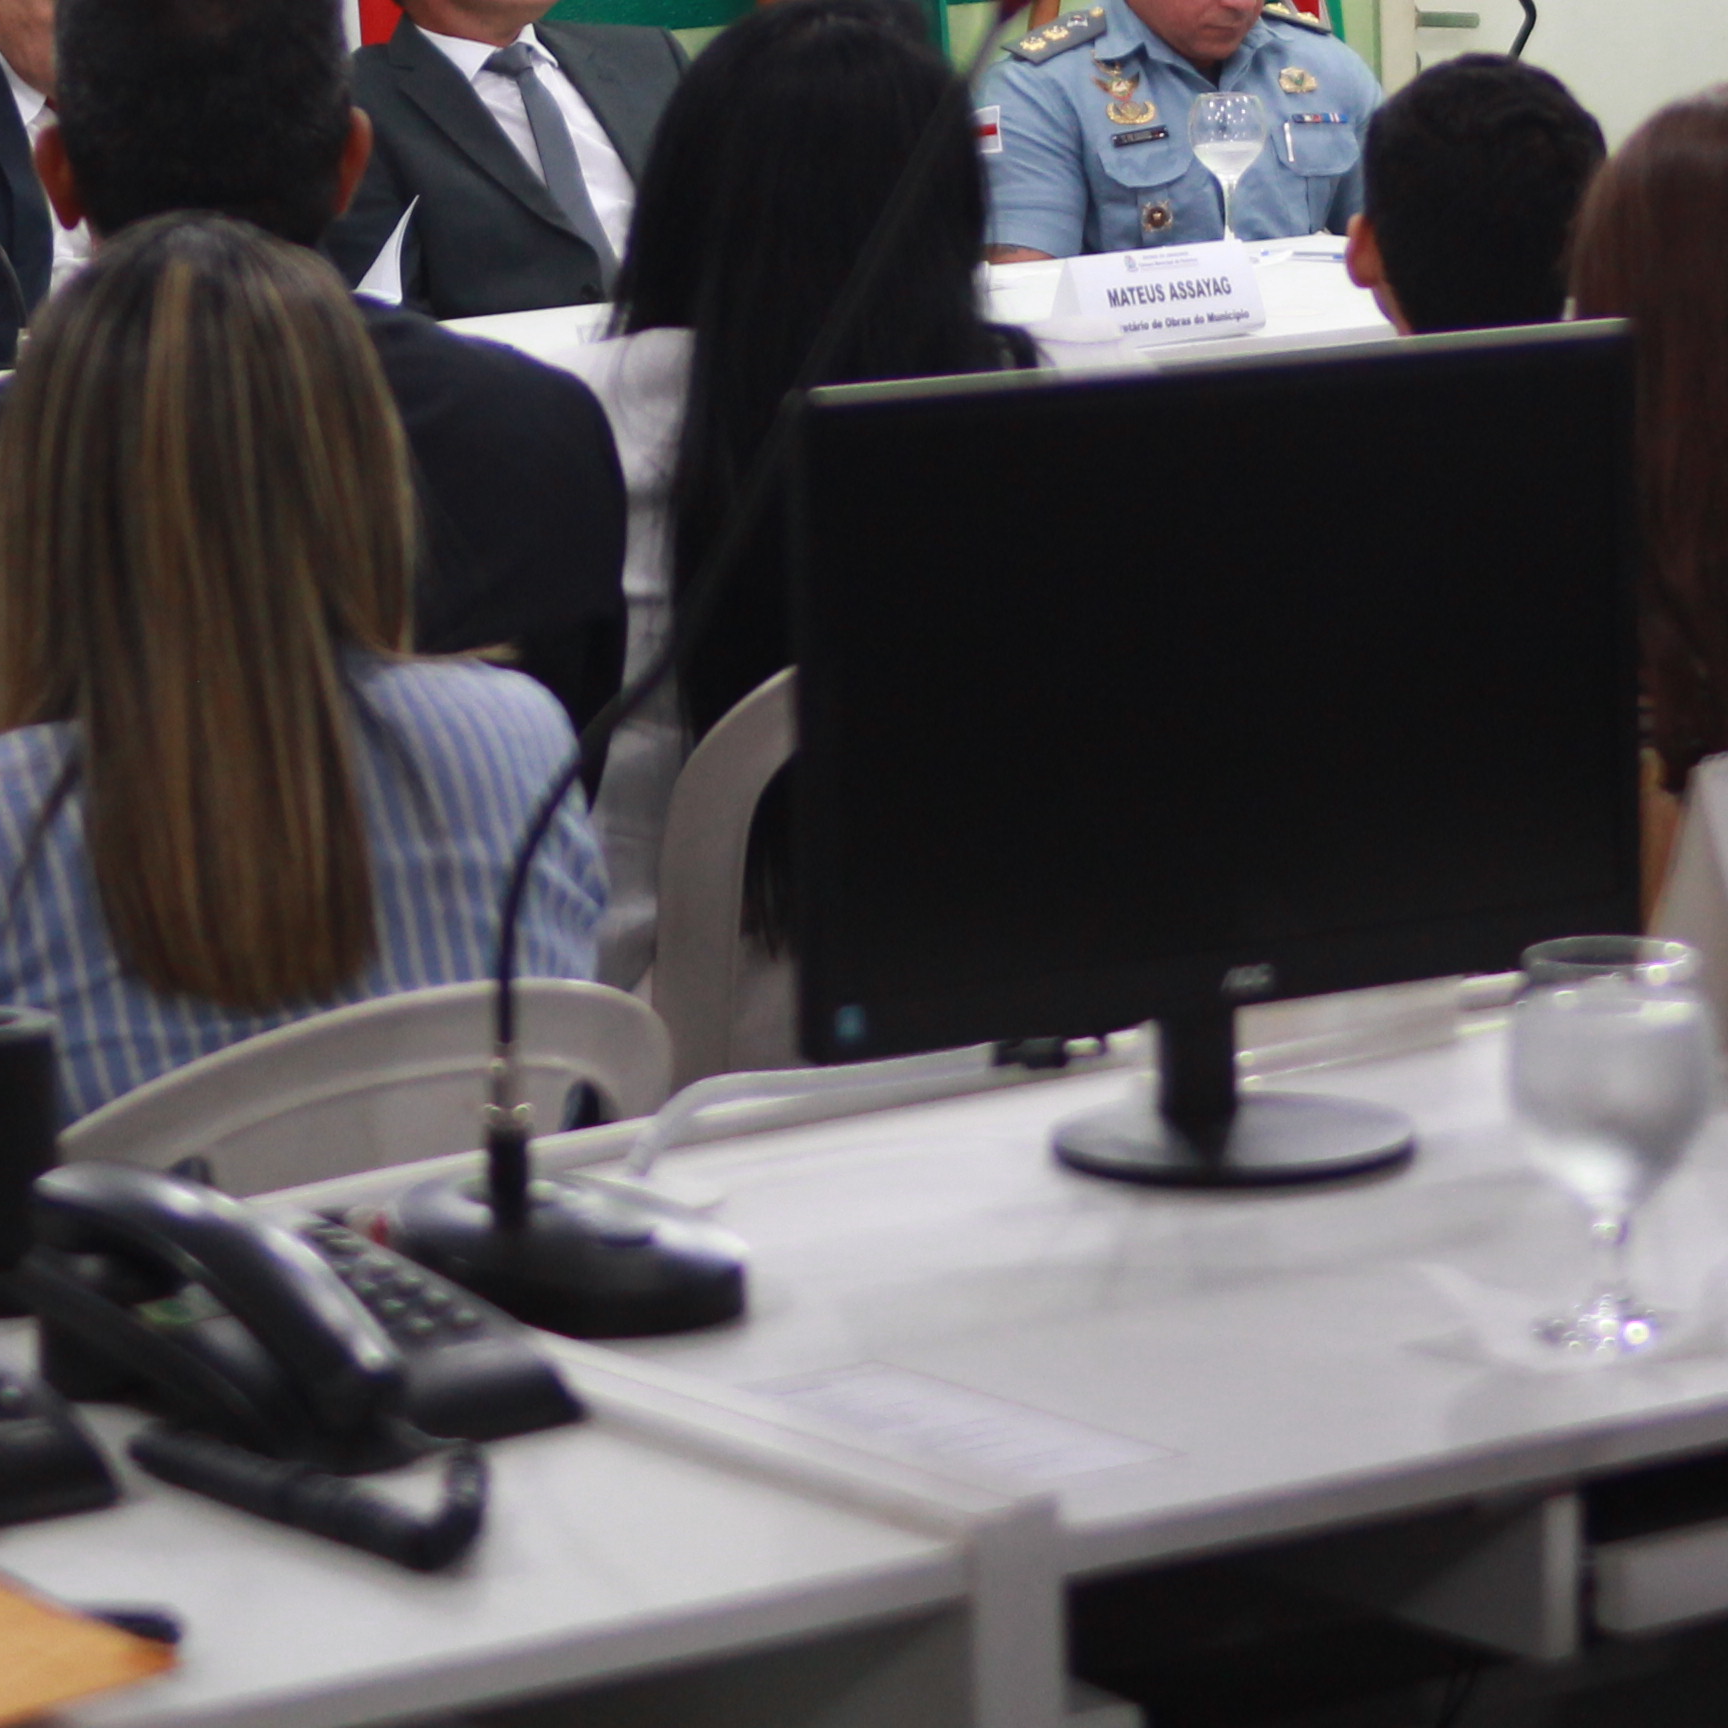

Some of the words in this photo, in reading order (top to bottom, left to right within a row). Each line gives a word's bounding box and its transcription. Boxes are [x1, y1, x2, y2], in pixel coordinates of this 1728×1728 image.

[1106, 283, 1166, 308] MATEUS
[1169, 276, 1232, 301] ASSAYAG
[1165, 316, 1192, 328] Obras
